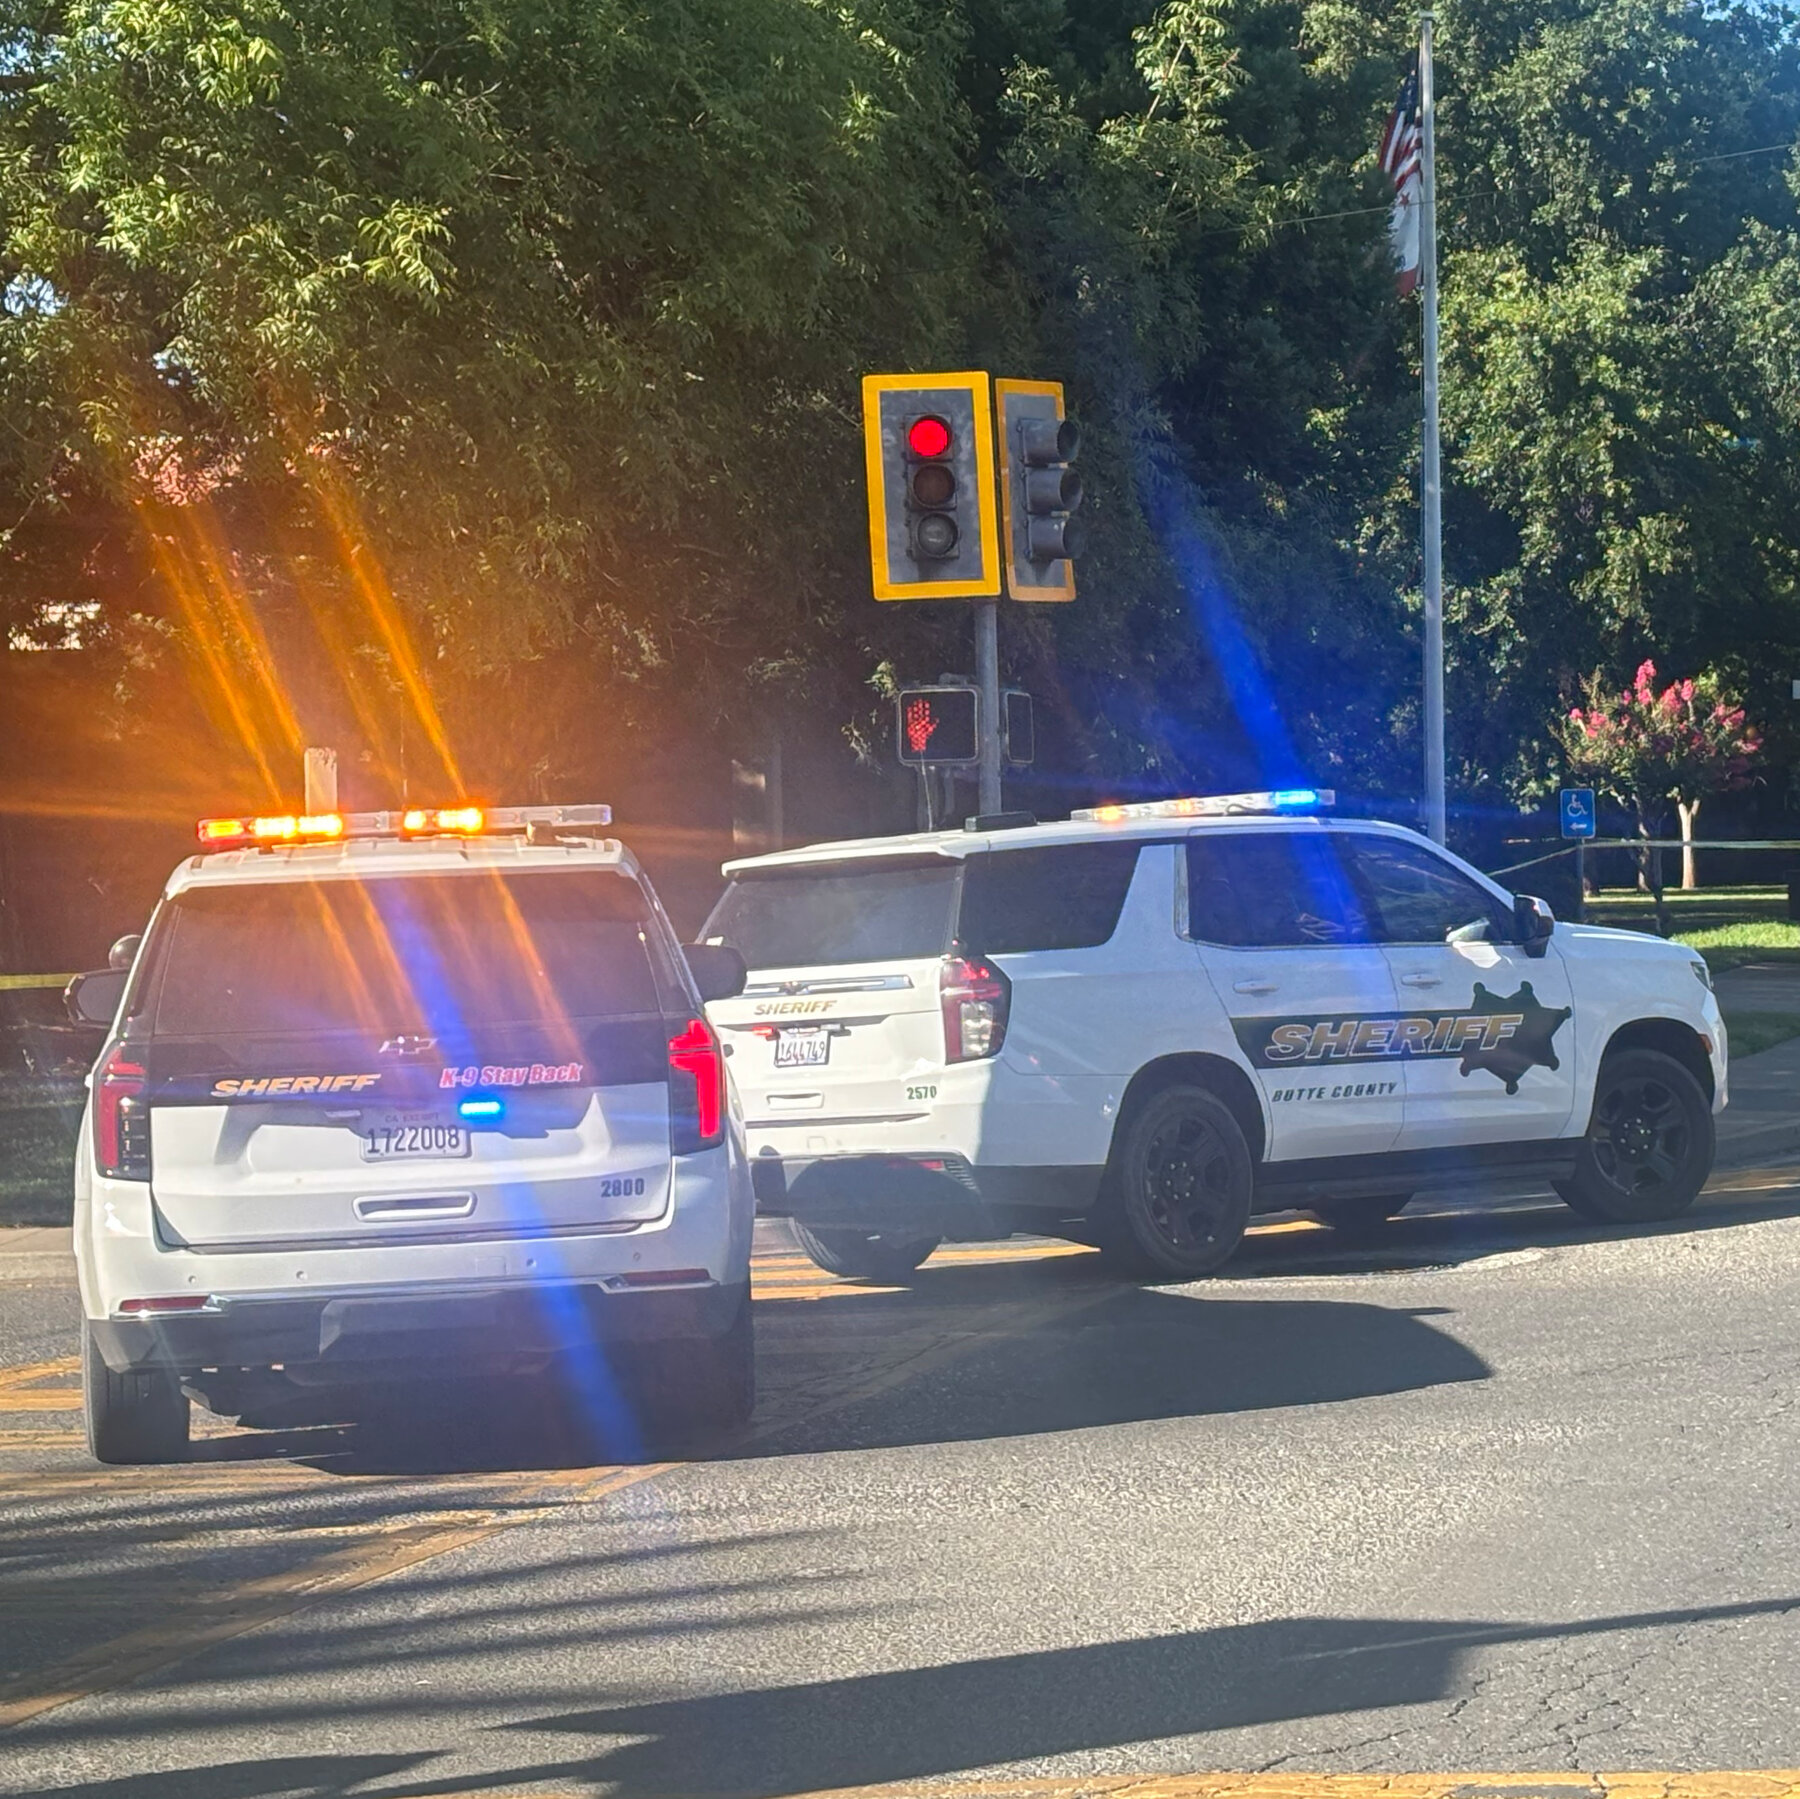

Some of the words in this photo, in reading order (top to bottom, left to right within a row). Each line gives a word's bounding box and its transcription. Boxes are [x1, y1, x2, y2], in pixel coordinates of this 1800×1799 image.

[754, 1000, 836, 1015] SHERIFF
[1264, 1013, 1524, 1061] SHERIFF
[211, 1073, 382, 1098] SHERIFF
[439, 1066, 477, 1088] K-9
[482, 1066, 527, 1088] Stay
[530, 1062, 583, 1083] Back
[906, 1085, 938, 1100] 2570
[1272, 1086, 1326, 1103] BUTTE
[1331, 1082, 1398, 1099] COUNTY
[367, 1124, 460, 1154] 1722008
[600, 1178, 645, 1198] 2800
